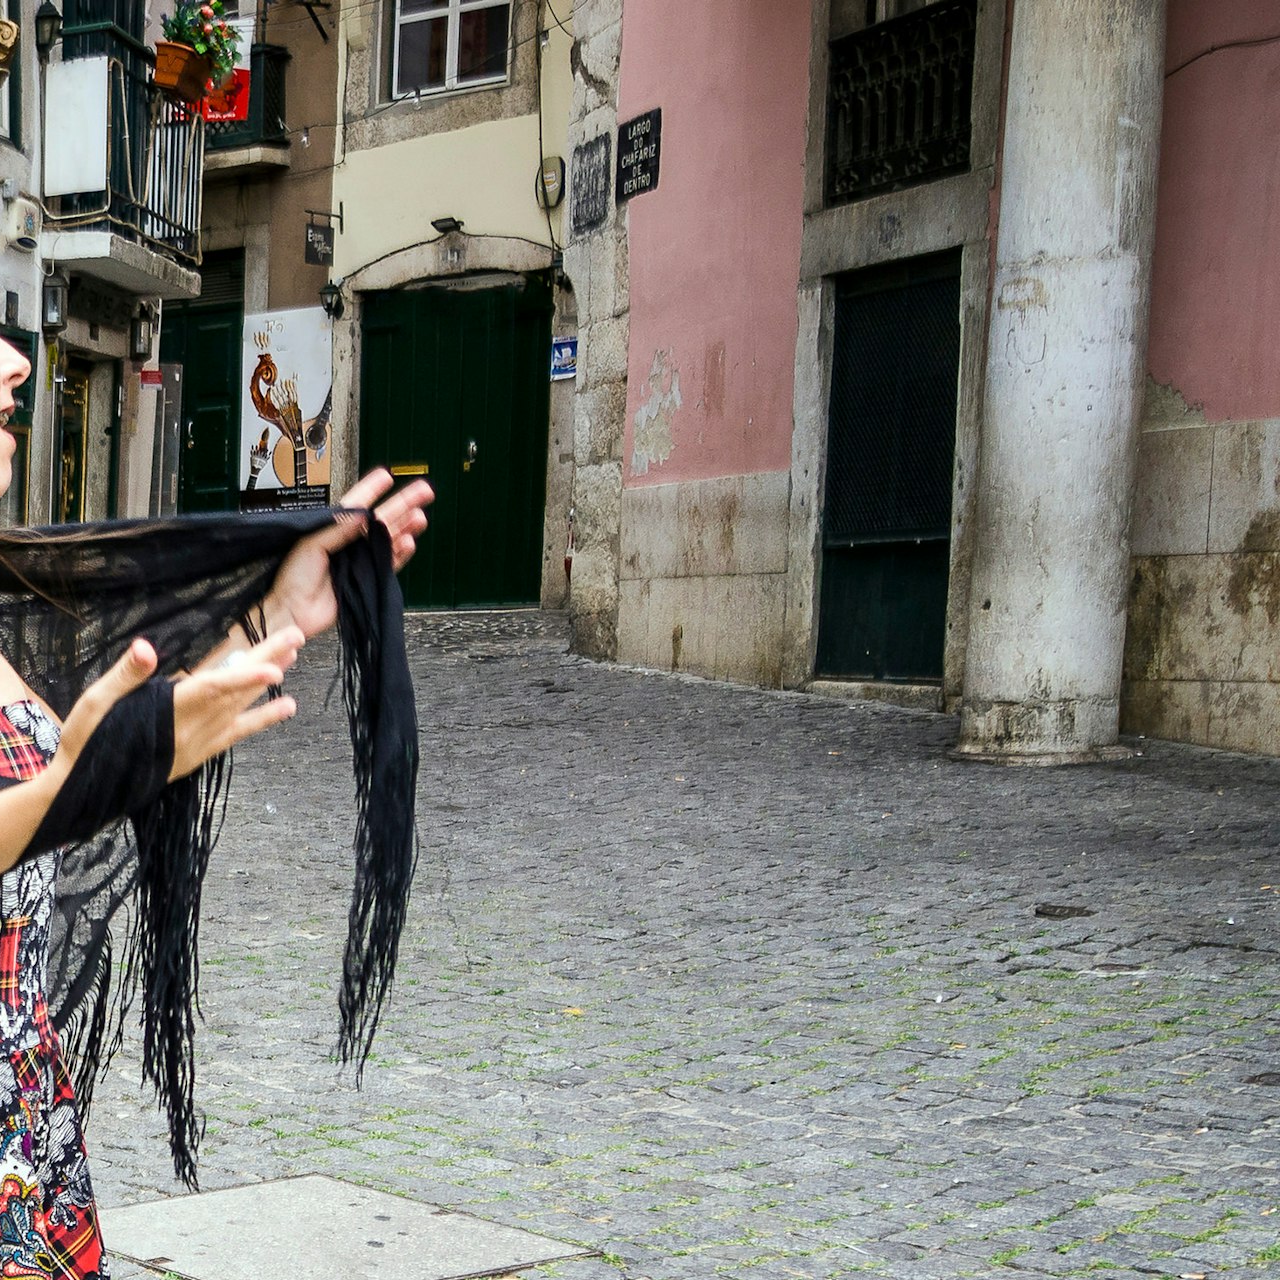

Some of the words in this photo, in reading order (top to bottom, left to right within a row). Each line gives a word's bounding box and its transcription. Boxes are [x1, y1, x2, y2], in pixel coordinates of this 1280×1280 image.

[629, 120, 651, 140] LARGO
[634, 137, 643, 150] DO
[622, 144, 656, 168] CHAFARIZ
[632, 164, 642, 177] DE
[624, 174, 650, 194] DENTRO
